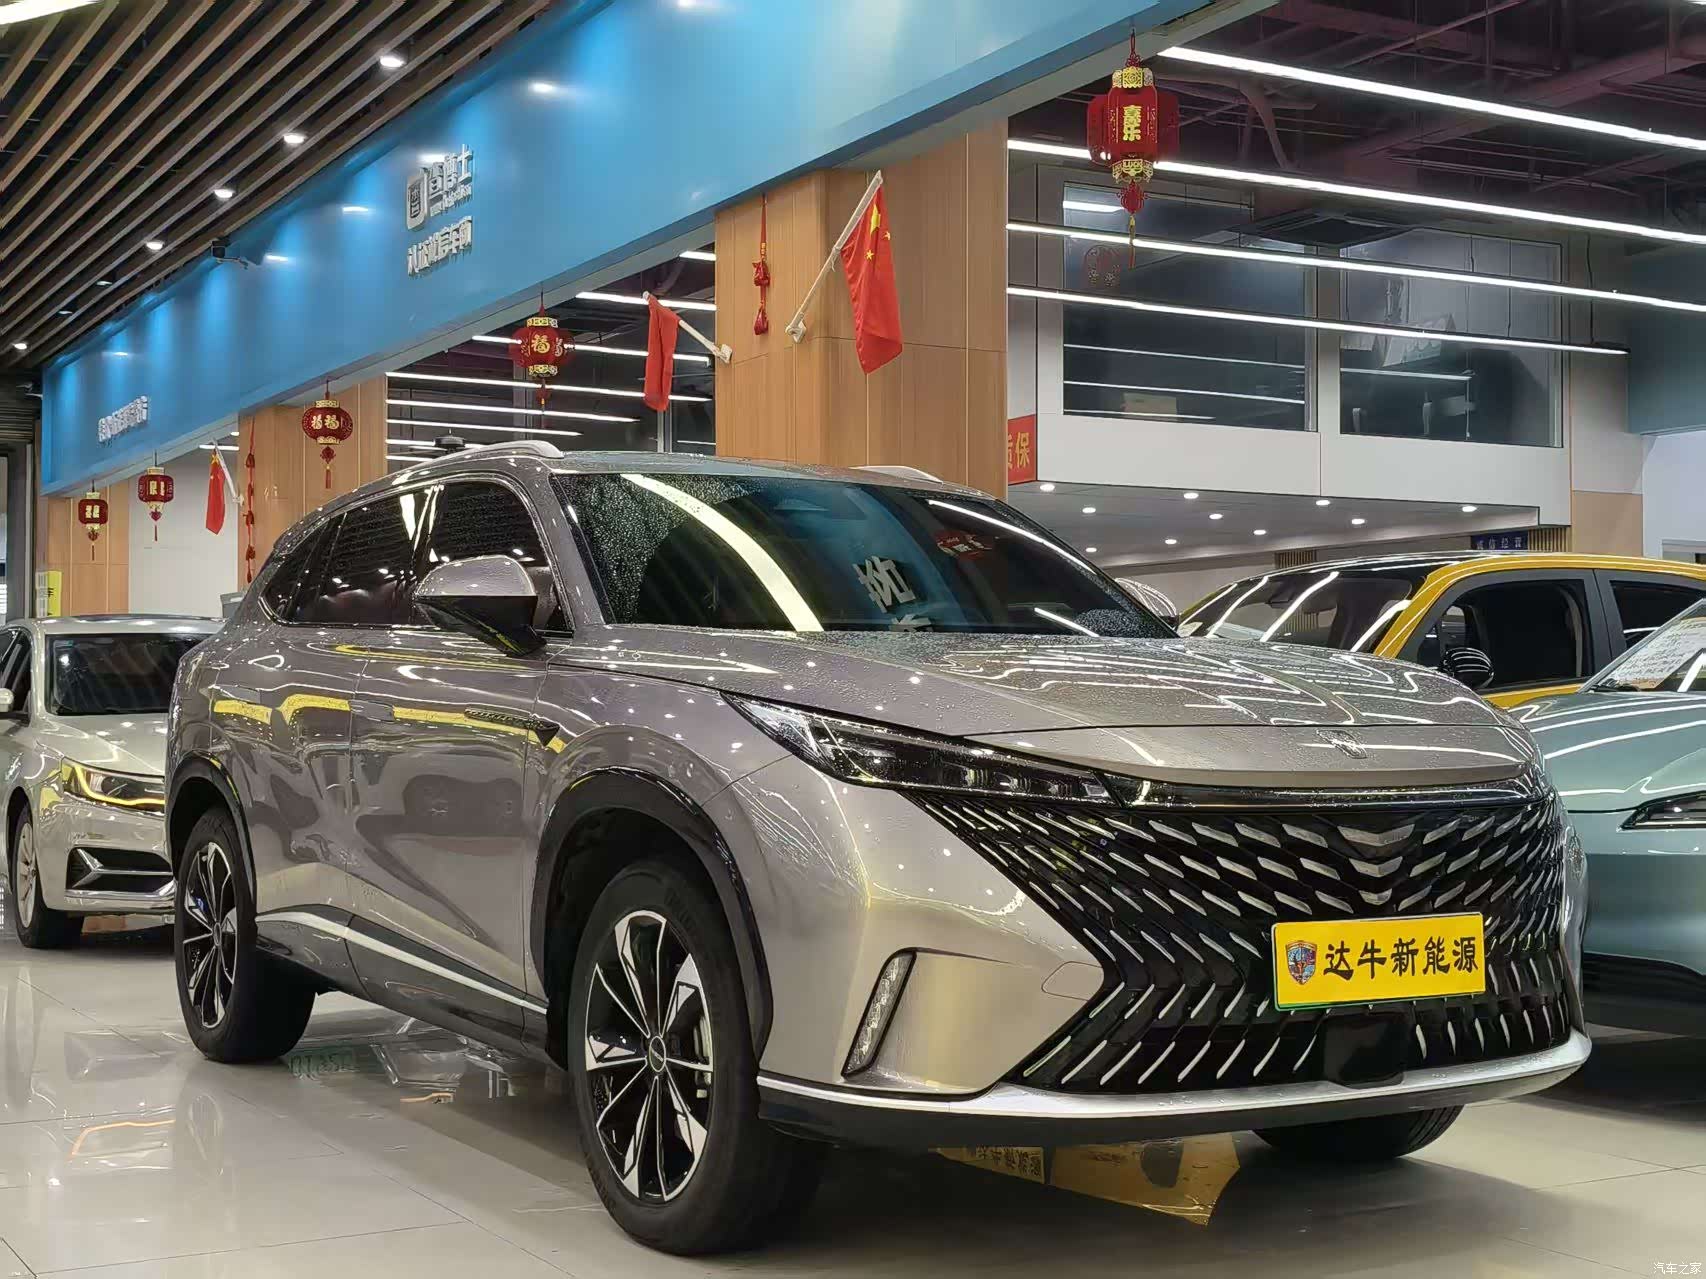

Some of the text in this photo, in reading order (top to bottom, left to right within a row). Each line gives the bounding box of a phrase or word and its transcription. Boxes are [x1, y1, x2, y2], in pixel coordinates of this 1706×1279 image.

[531, 333, 551, 354] 福
[1323, 936, 1479, 981] 达牛新能源
